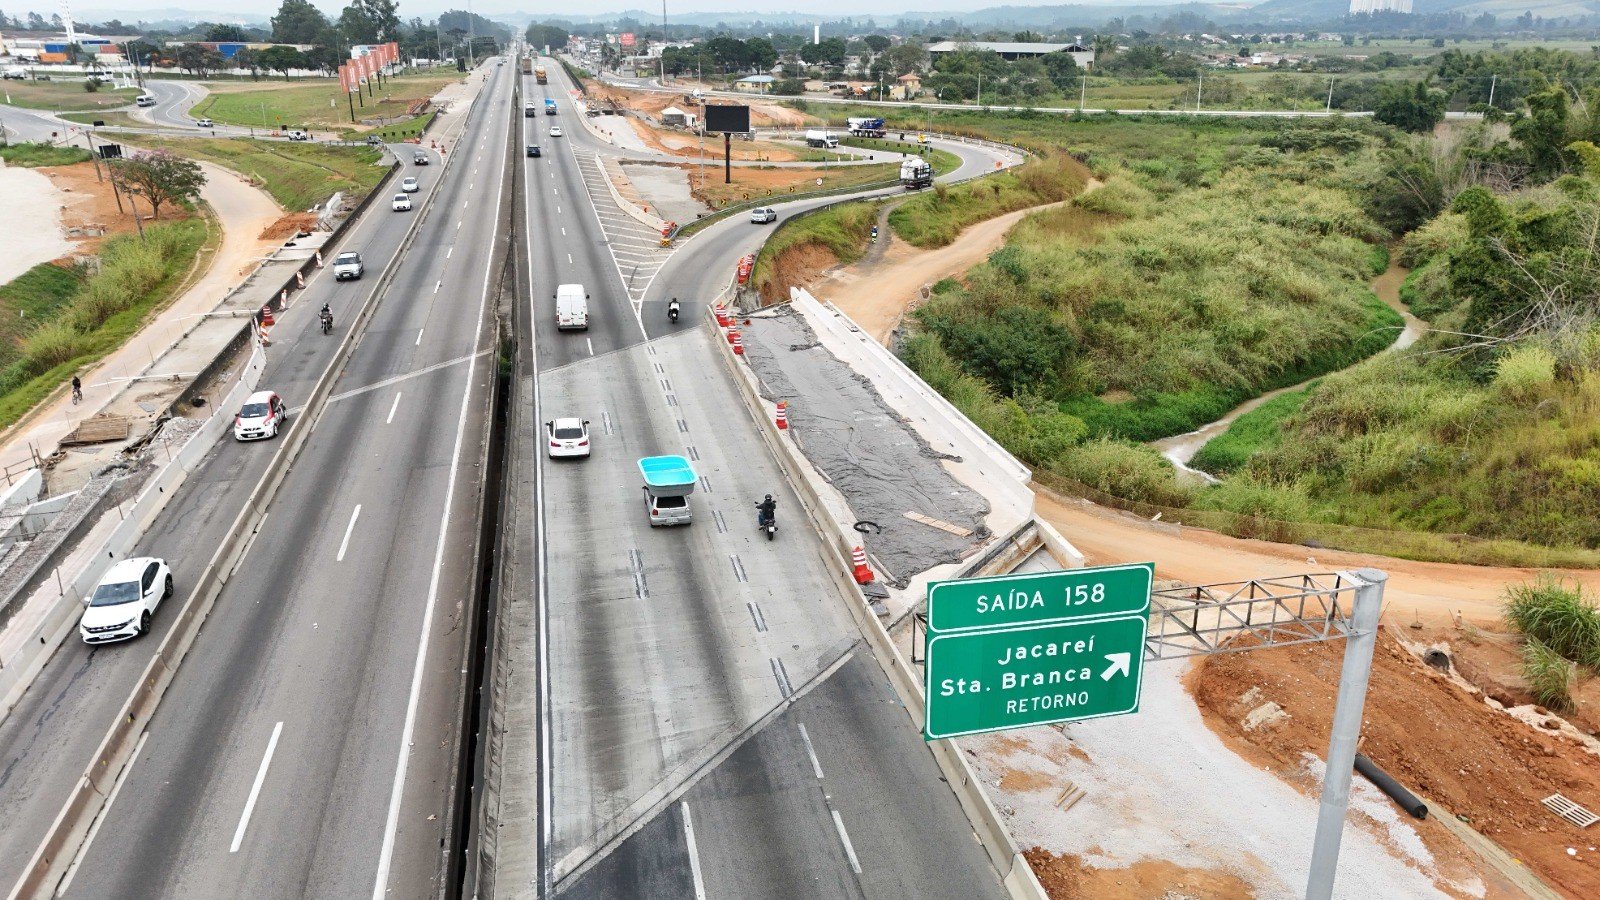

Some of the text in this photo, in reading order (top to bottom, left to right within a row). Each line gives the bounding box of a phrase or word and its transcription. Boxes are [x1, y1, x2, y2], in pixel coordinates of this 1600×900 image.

[976, 582, 1105, 614] SAÍDA 158
[997, 635, 1095, 666] Jacareí
[940, 667, 1091, 697] Sta. Branca
[1006, 691, 1089, 714] RETORNO
